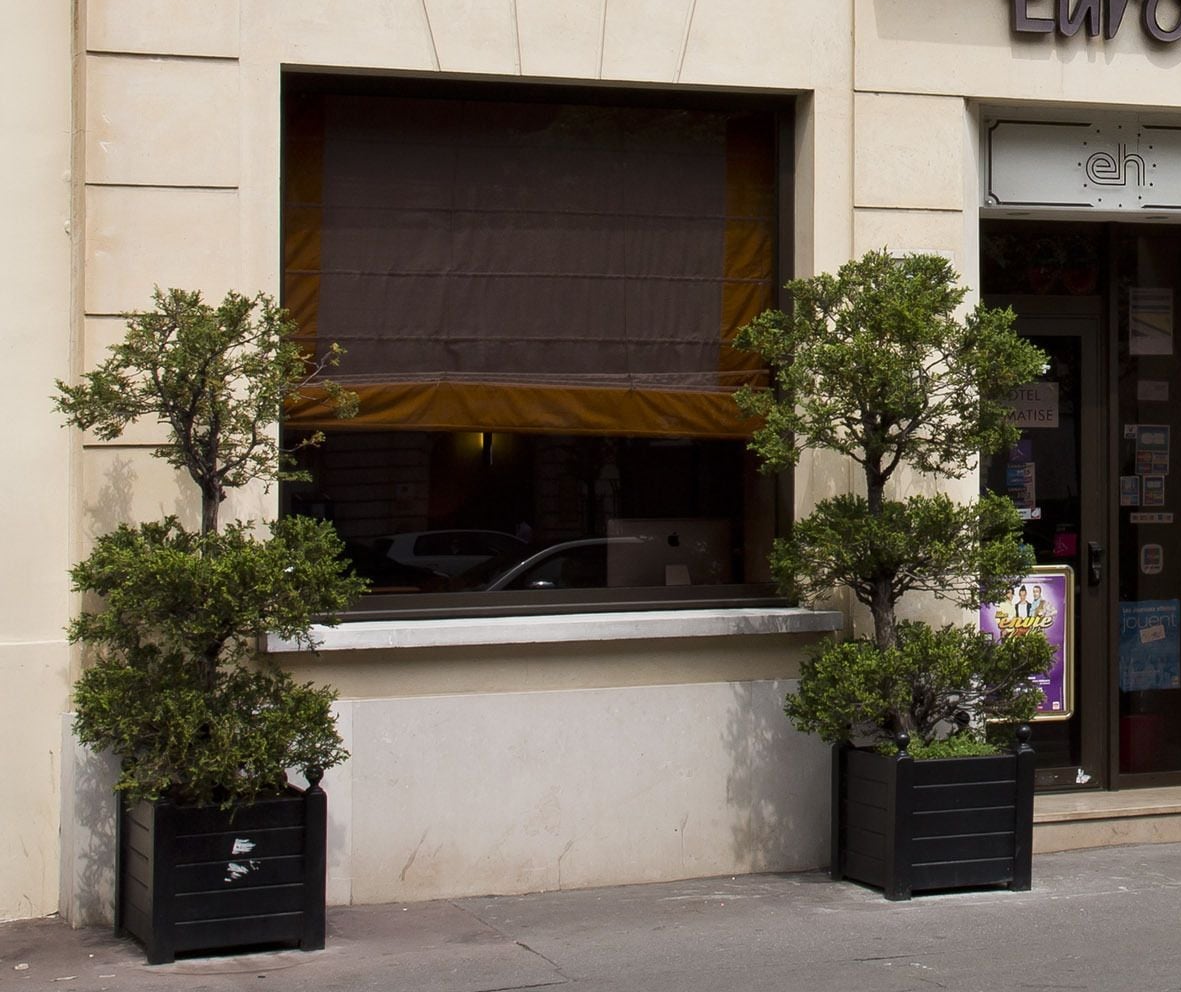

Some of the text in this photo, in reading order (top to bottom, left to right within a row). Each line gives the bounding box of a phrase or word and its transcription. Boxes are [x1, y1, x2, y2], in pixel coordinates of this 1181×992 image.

[1086, 143, 1145, 186] eh
[999, 614, 1053, 629] envie
[1123, 610, 1177, 633] jouent
